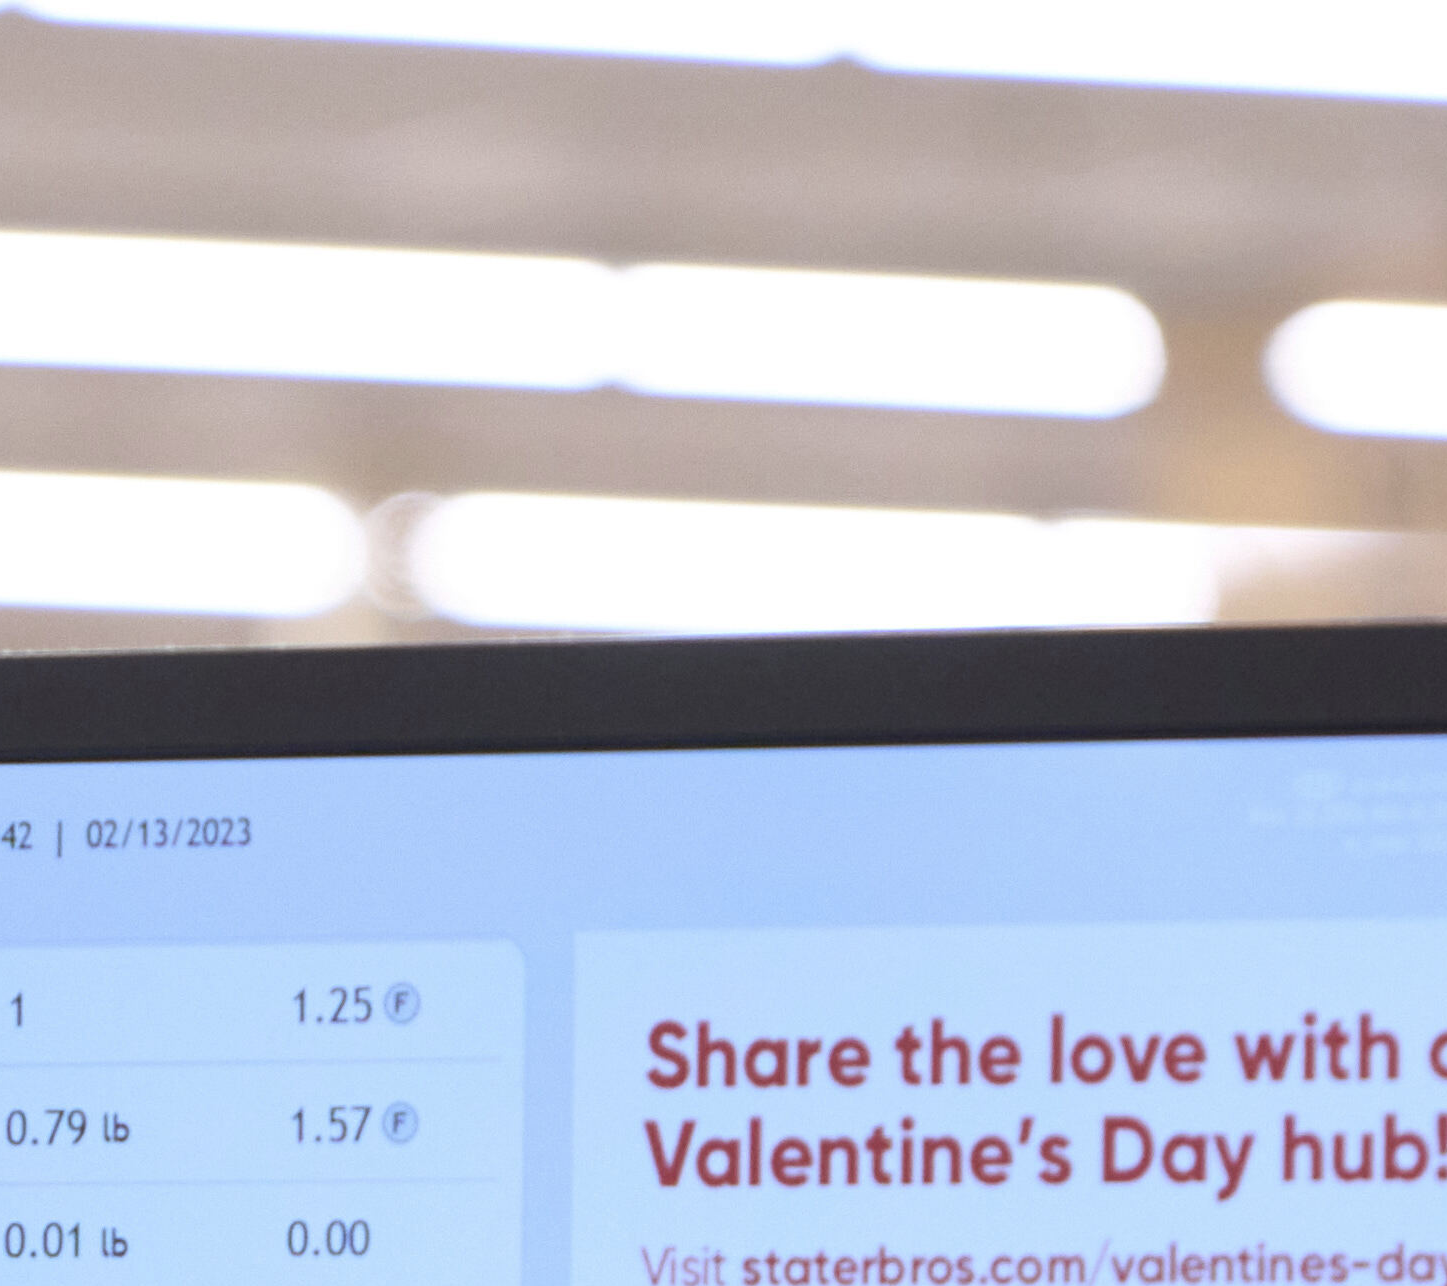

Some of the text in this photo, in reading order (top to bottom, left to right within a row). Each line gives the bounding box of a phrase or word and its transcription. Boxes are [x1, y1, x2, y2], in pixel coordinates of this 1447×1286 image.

[86, 817, 251, 849] 02/13/2023
[9, 993, 23, 1026] 1
[295, 987, 372, 1023] 1.25
[648, 1021, 870, 1089] Share
[895, 1019, 1021, 1085] the
[1051, 1015, 1206, 1084] love
[1235, 1013, 1399, 1081] with
[6, 1109, 87, 1146] 0.79
[104, 1114, 130, 1143] lb
[293, 1106, 371, 1142] 1.57
[1103, 1116, 1253, 1201] Day
[4, 1222, 80, 1258] 0.01
[102, 1229, 128, 1258] lb
[287, 1220, 370, 1257] 0.00
